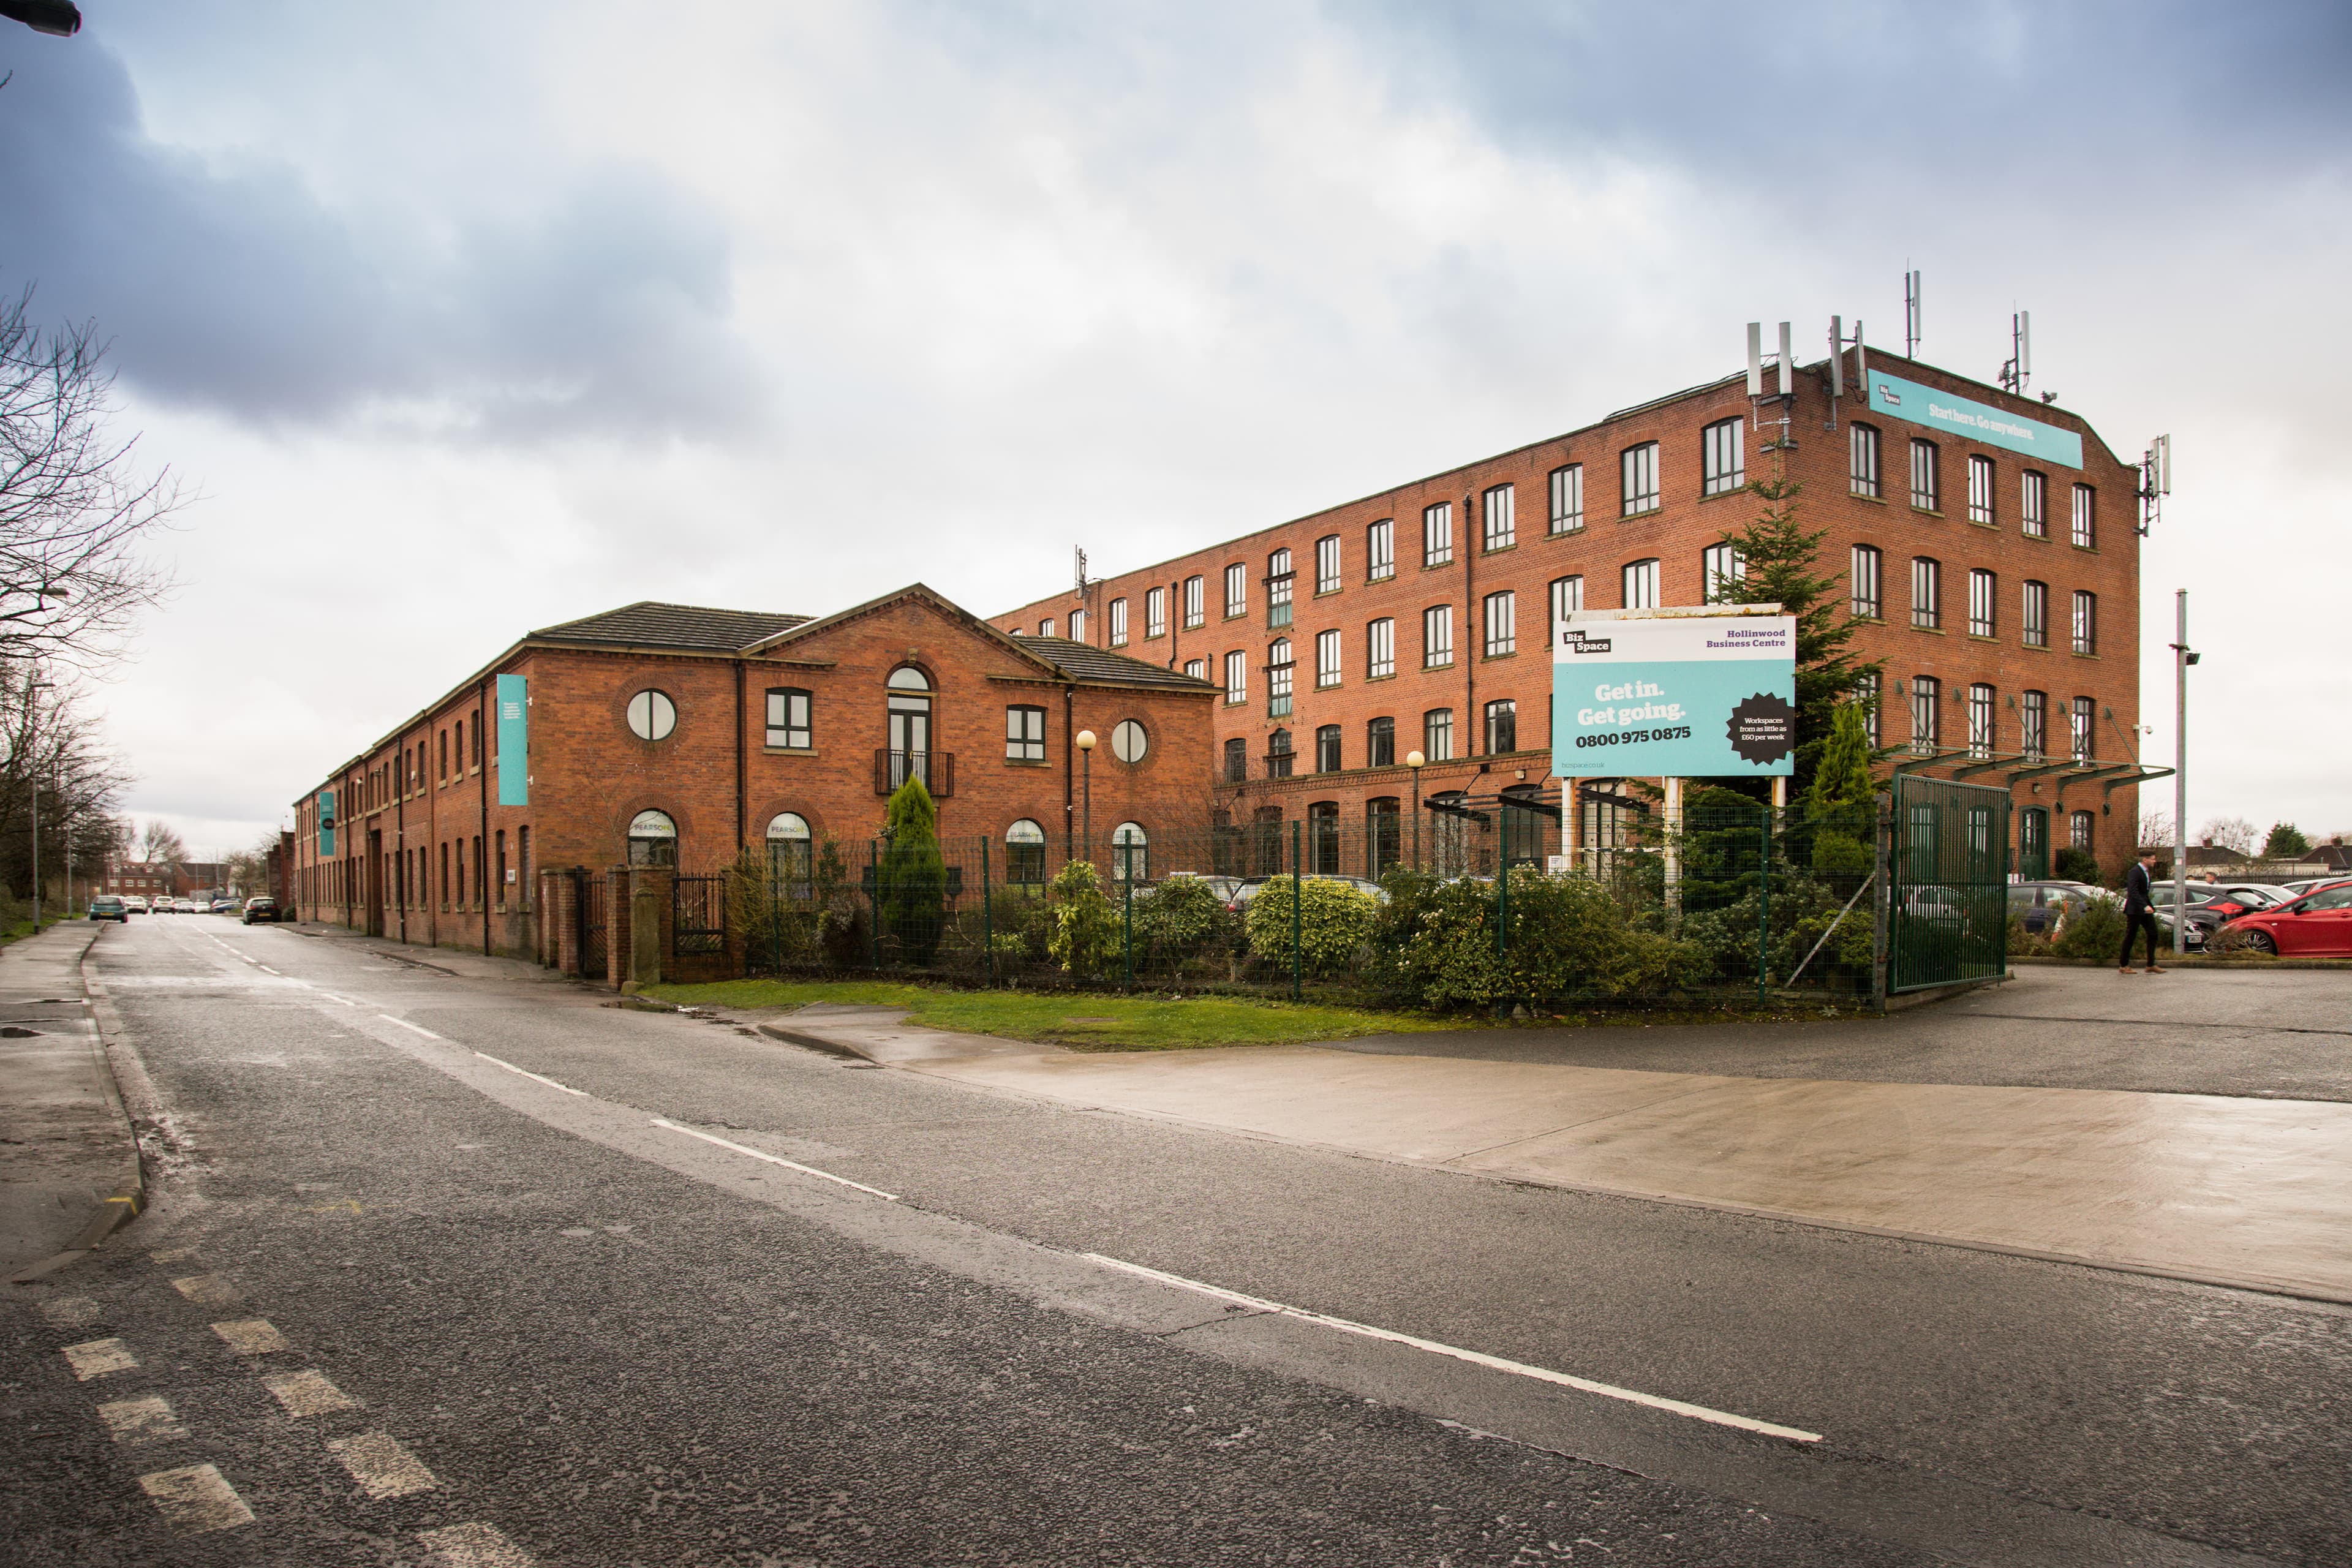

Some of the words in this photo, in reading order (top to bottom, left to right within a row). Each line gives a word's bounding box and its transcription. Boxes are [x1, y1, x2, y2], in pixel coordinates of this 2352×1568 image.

[1885, 394, 1900, 404] Space
[1929, 403, 1953, 421] Start
[1953, 409, 1977, 426] here.
[1977, 415, 1989, 429] Go
[1990, 421, 2034, 440] anywhere.
[1566, 633, 1583, 642] Biz
[1577, 642, 1609, 652] Space
[1595, 684, 1634, 701] Get
[1635, 680, 1665, 698] in.
[1577, 707, 1616, 726] Get
[1618, 701, 1686, 726] going.
[1575, 733, 1619, 748] 0800
[1621, 729, 1649, 744] 975
[1651, 726, 1691, 741] 0875
